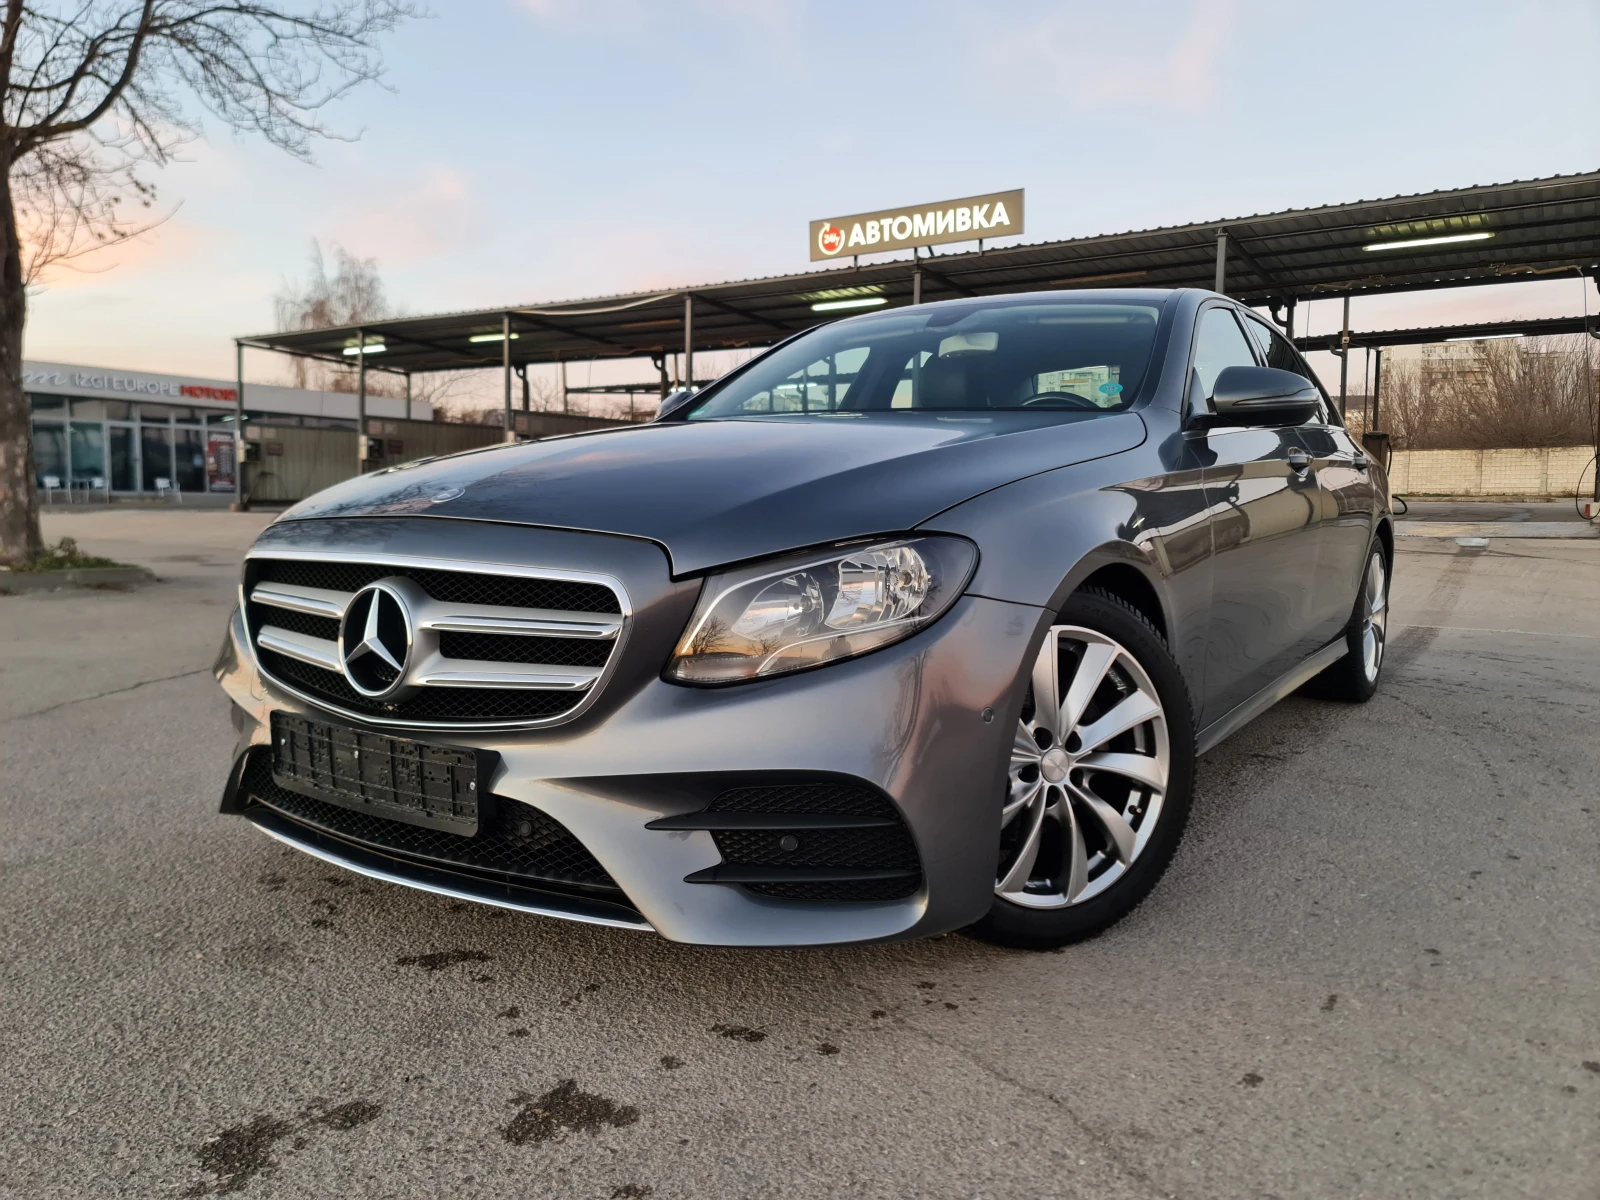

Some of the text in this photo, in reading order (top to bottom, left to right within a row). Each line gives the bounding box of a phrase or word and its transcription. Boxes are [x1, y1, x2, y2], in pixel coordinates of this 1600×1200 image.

[848, 201, 1011, 247] АВТОМИВКА
[74, 372, 109, 389] IZGI
[112, 376, 180, 396] EUROPE
